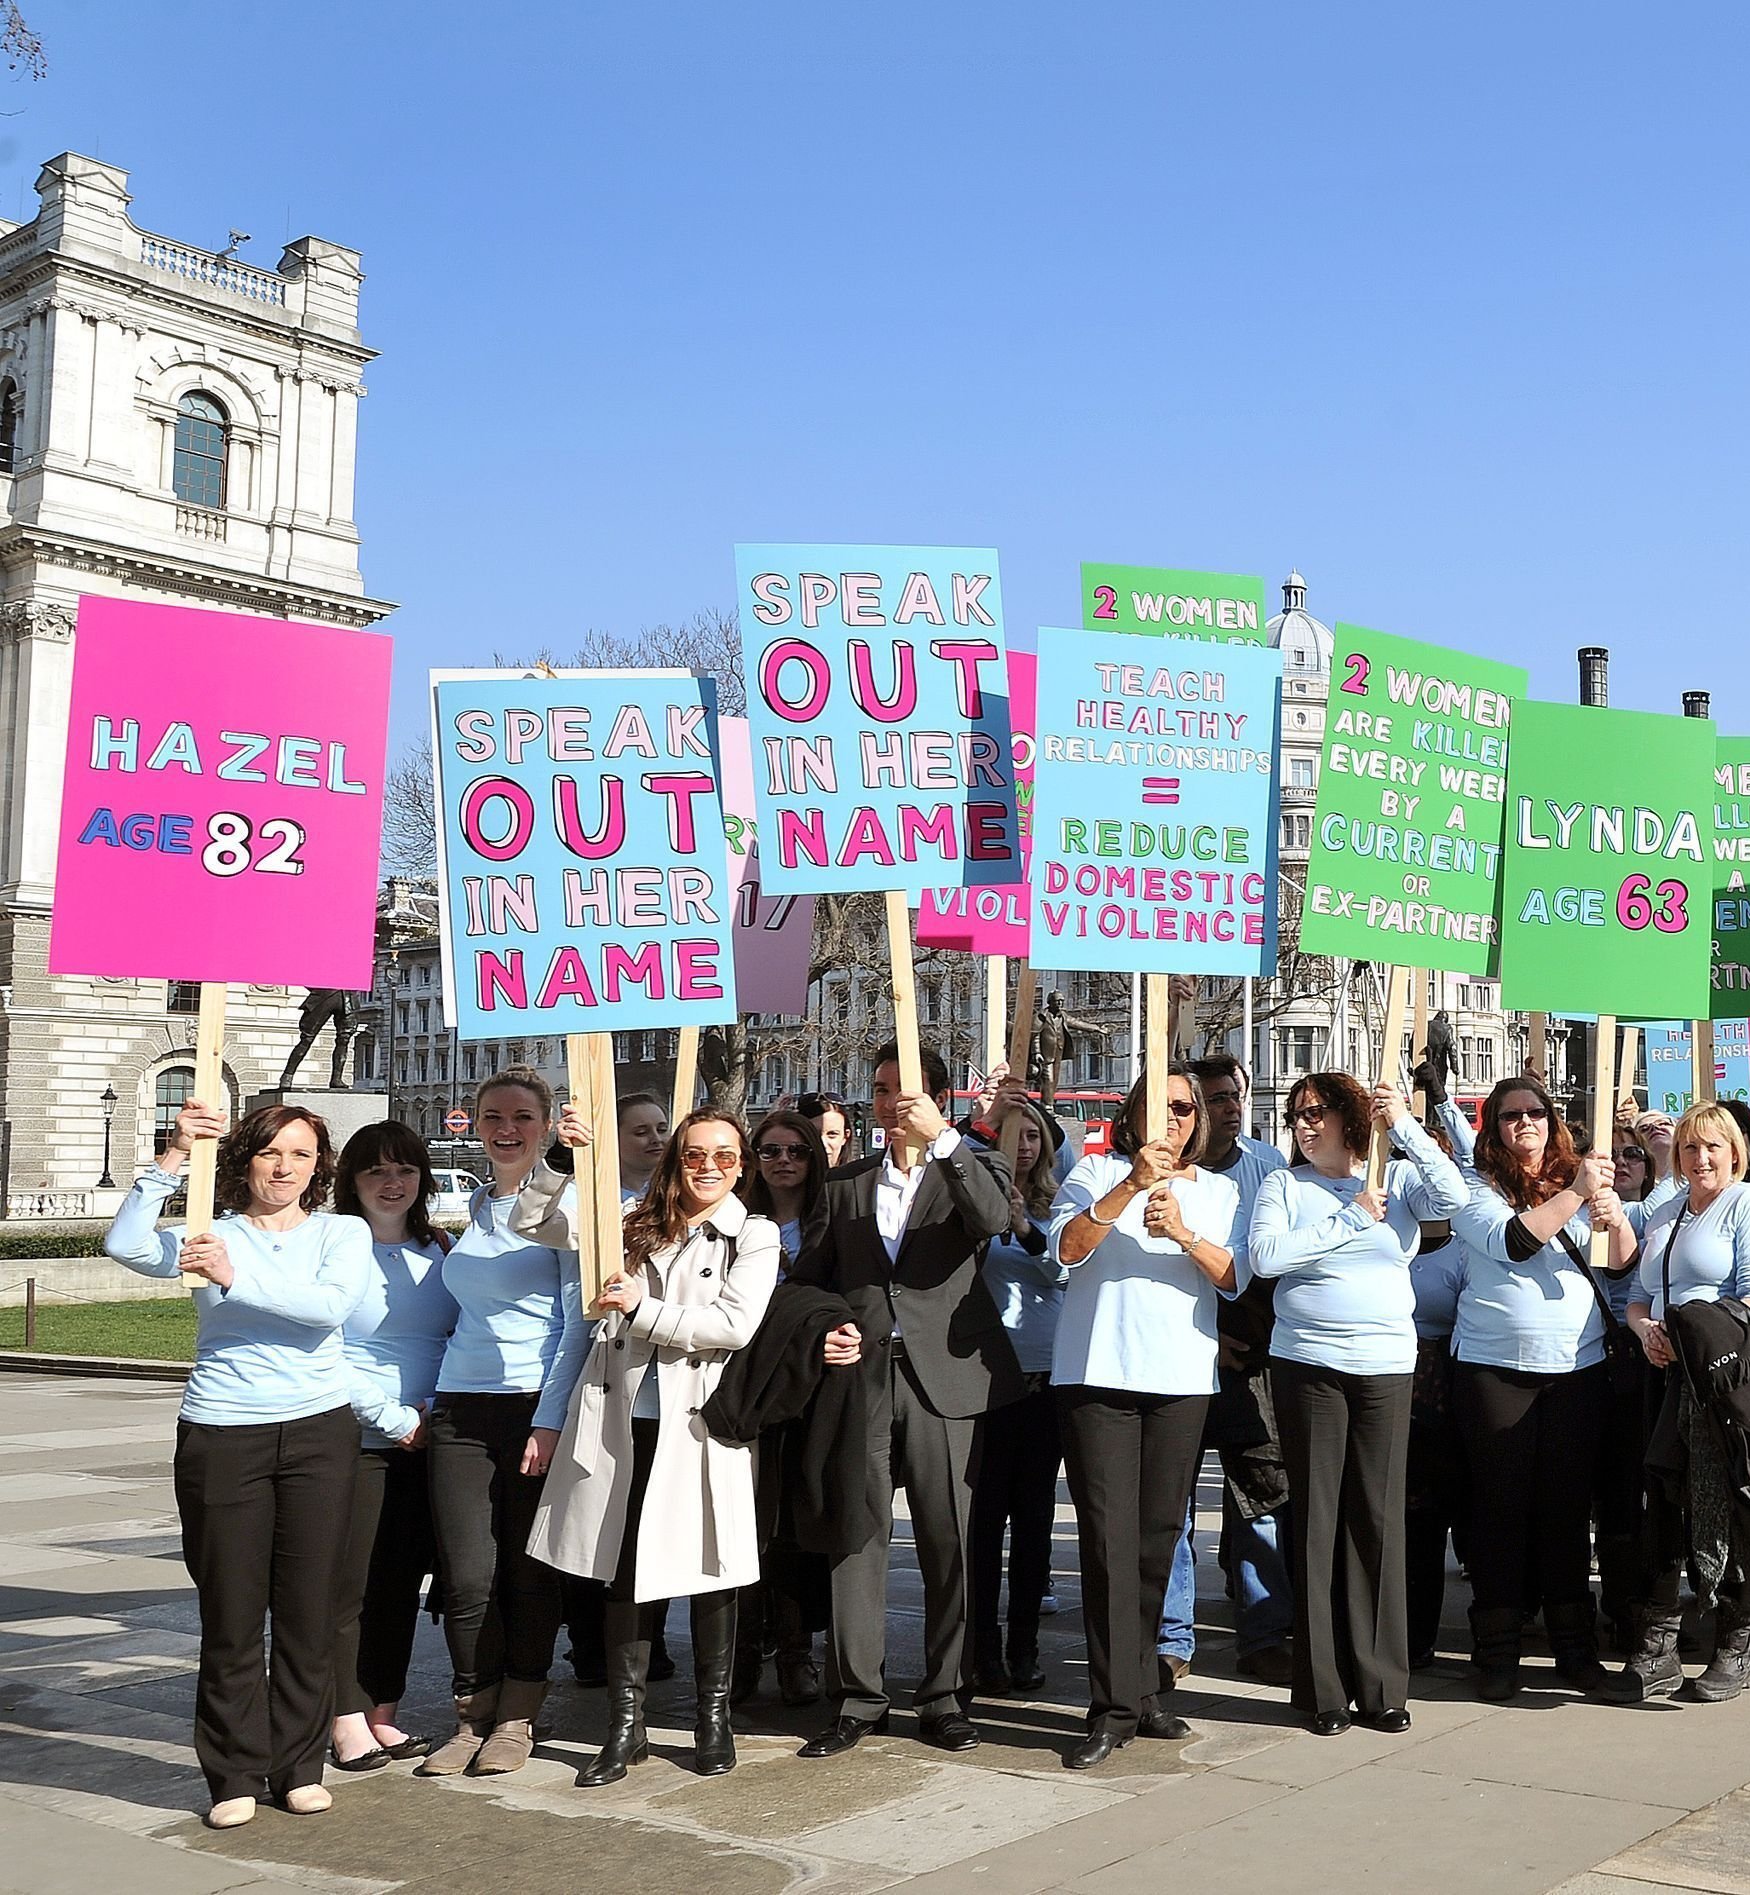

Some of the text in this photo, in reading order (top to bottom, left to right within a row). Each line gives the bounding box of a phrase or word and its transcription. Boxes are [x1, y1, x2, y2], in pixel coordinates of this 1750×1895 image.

[751, 572, 995, 627] SPEAK
[1093, 585, 1258, 630] 2 WOMEN
[758, 637, 999, 724] OUT
[1094, 662, 1225, 702] TEACH
[1340, 653, 1511, 729] 2 WOMEN
[456, 705, 713, 763] SPEAK
[1077, 700, 1247, 739] HEALTHY
[1333, 709, 1392, 744] ARE
[90, 715, 367, 796] HAZEL
[763, 736, 838, 794] IN
[861, 731, 1007, 790] HER
[1044, 735, 1273, 775] RELATIONSHIPS
[1329, 744, 1427, 788] EVERY
[460, 773, 714, 861] OUT
[776, 801, 1013, 868] NAME
[1380, 788, 1466, 832] BY A
[1516, 795, 1704, 863] LYNDA
[78, 808, 304, 877] AGE 82
[1060, 817, 1250, 864] REDUCE
[1320, 812, 1503, 881] CURRENT
[464, 867, 720, 936] IN HER
[1044, 861, 1266, 905] DOMESTIC
[1403, 873, 1431, 897] OR
[1519, 888, 1607, 926] AGE
[1615, 873, 1689, 933] 63
[1727, 869, 1746, 893] A
[1041, 899, 1266, 945] VIOLENCE
[1311, 885, 1498, 946] EX-PARTNER
[475, 940, 724, 1011] NAME
